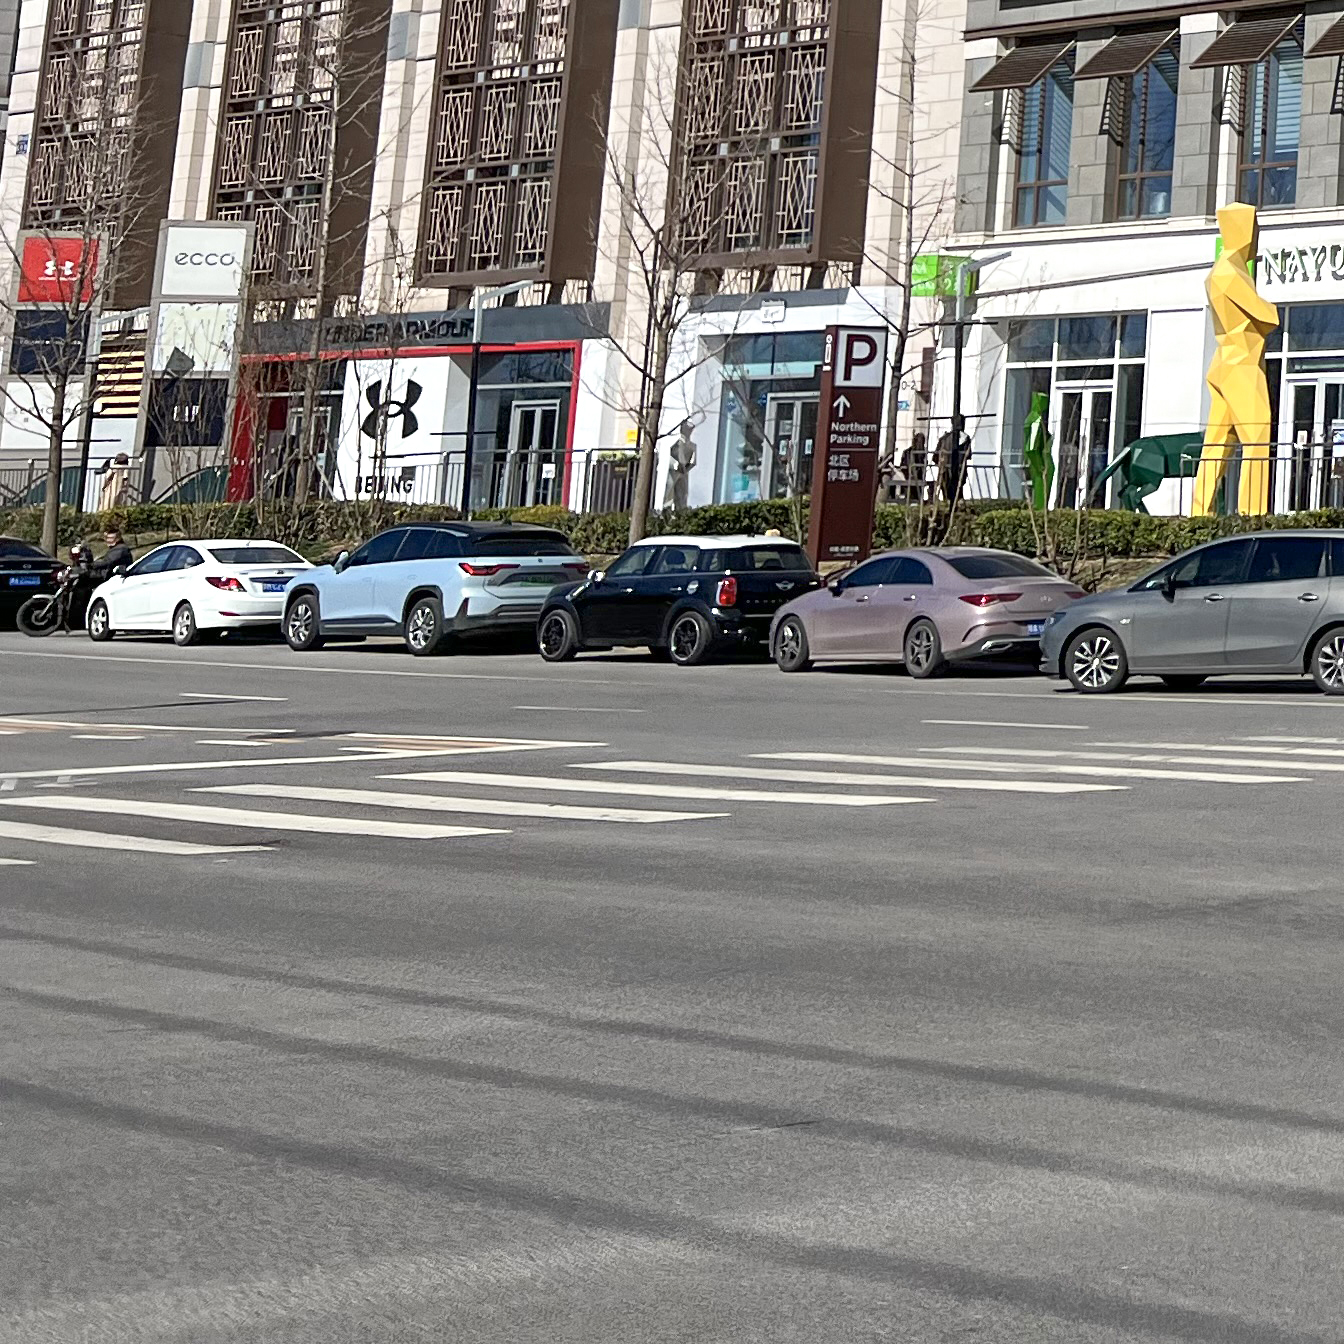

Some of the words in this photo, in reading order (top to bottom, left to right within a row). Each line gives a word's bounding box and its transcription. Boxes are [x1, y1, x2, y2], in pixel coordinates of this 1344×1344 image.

[174, 252, 235, 266] ecco
[843, 333, 878, 381] P
[831, 422, 877, 432] Northern
[830, 434, 870, 446] Parking
[829, 455, 850, 467] 北区
[828, 469, 859, 481] 停车场
